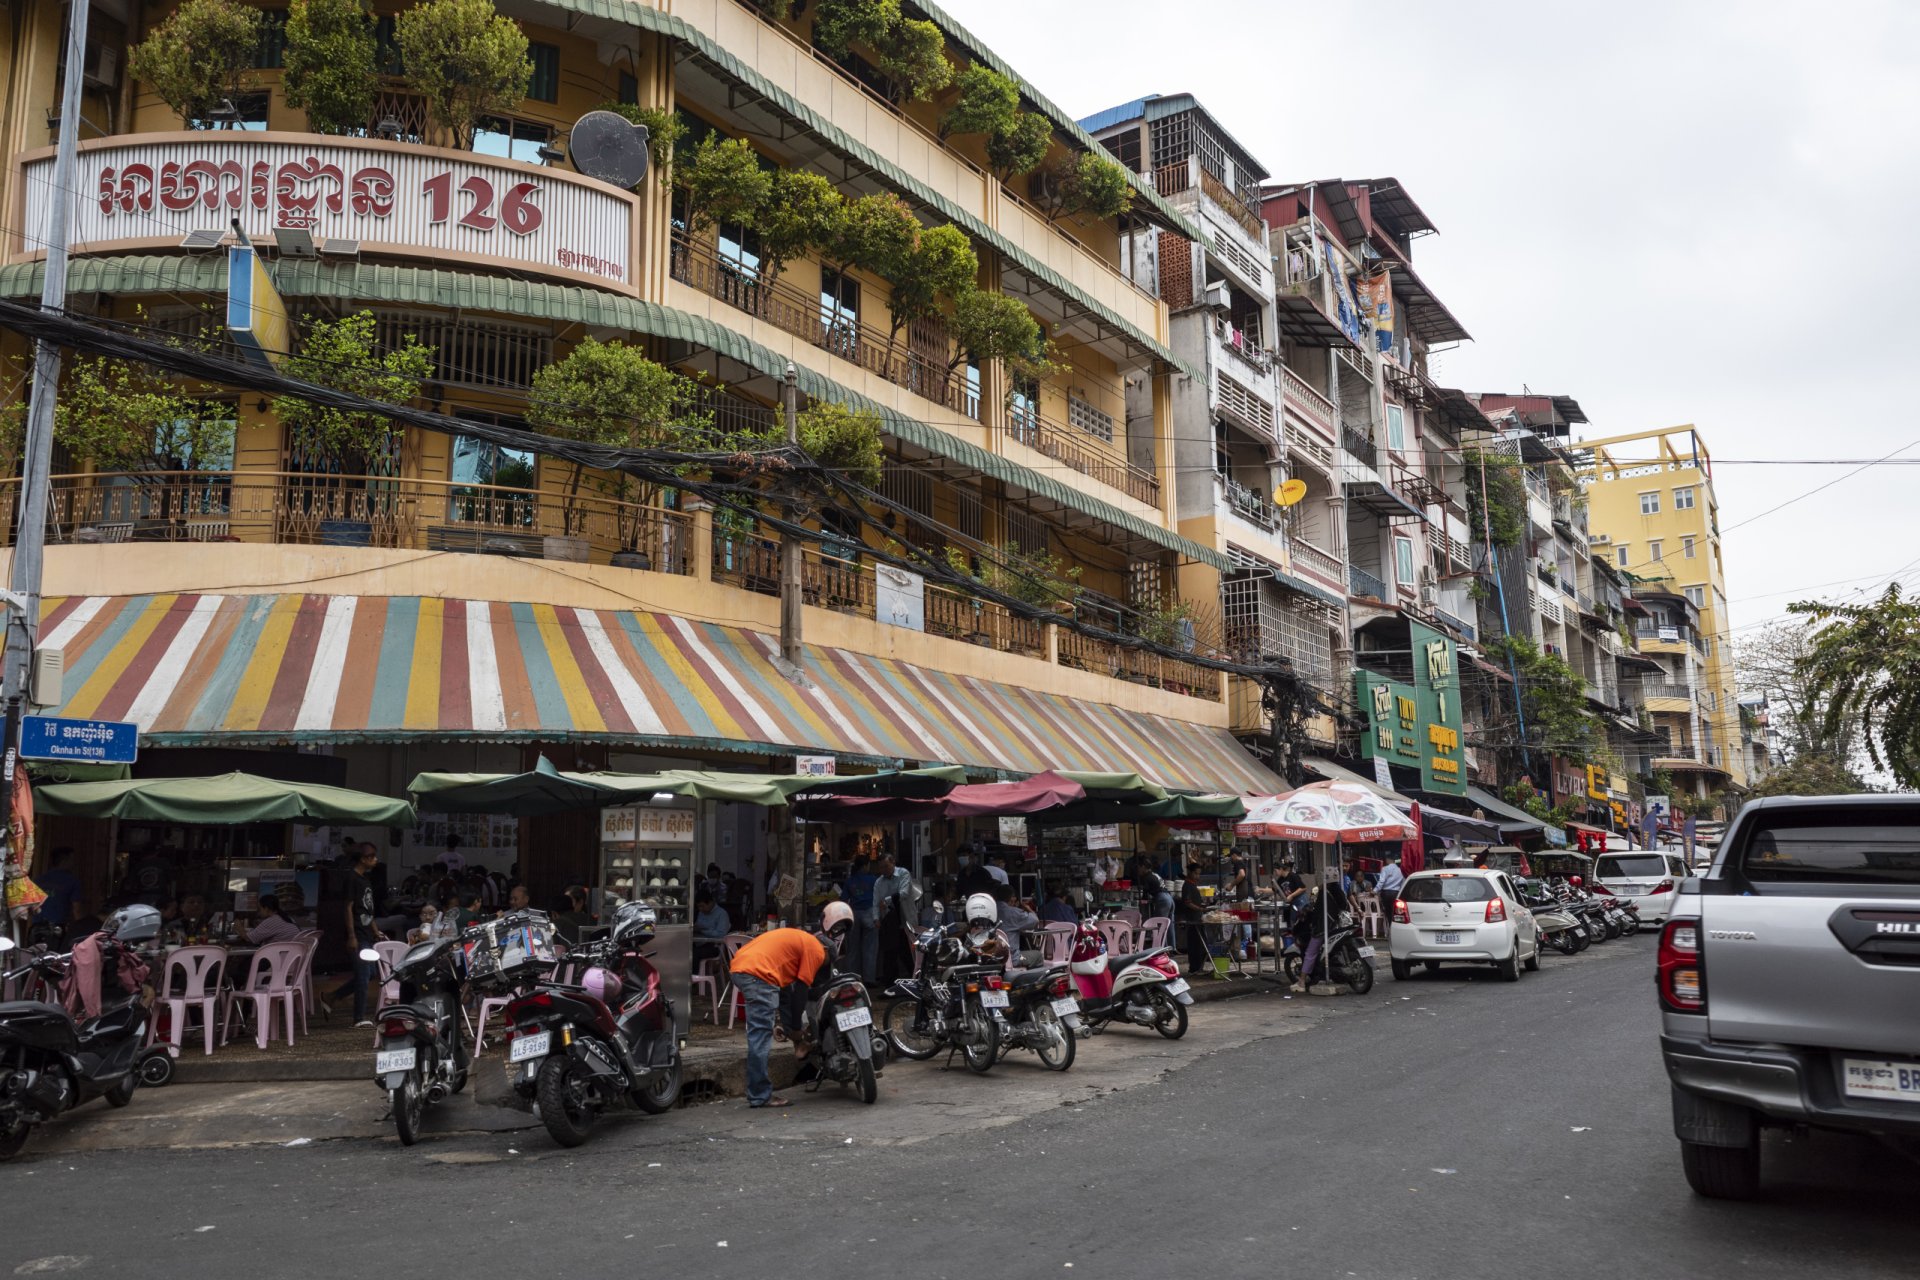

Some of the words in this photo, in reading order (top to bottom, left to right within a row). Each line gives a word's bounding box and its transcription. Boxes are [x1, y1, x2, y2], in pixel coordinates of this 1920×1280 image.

[423, 171, 543, 236] 126
[1709, 930, 1757, 940] TOYOTA
[1848, 1083, 1897, 1091] CAMBODIA
